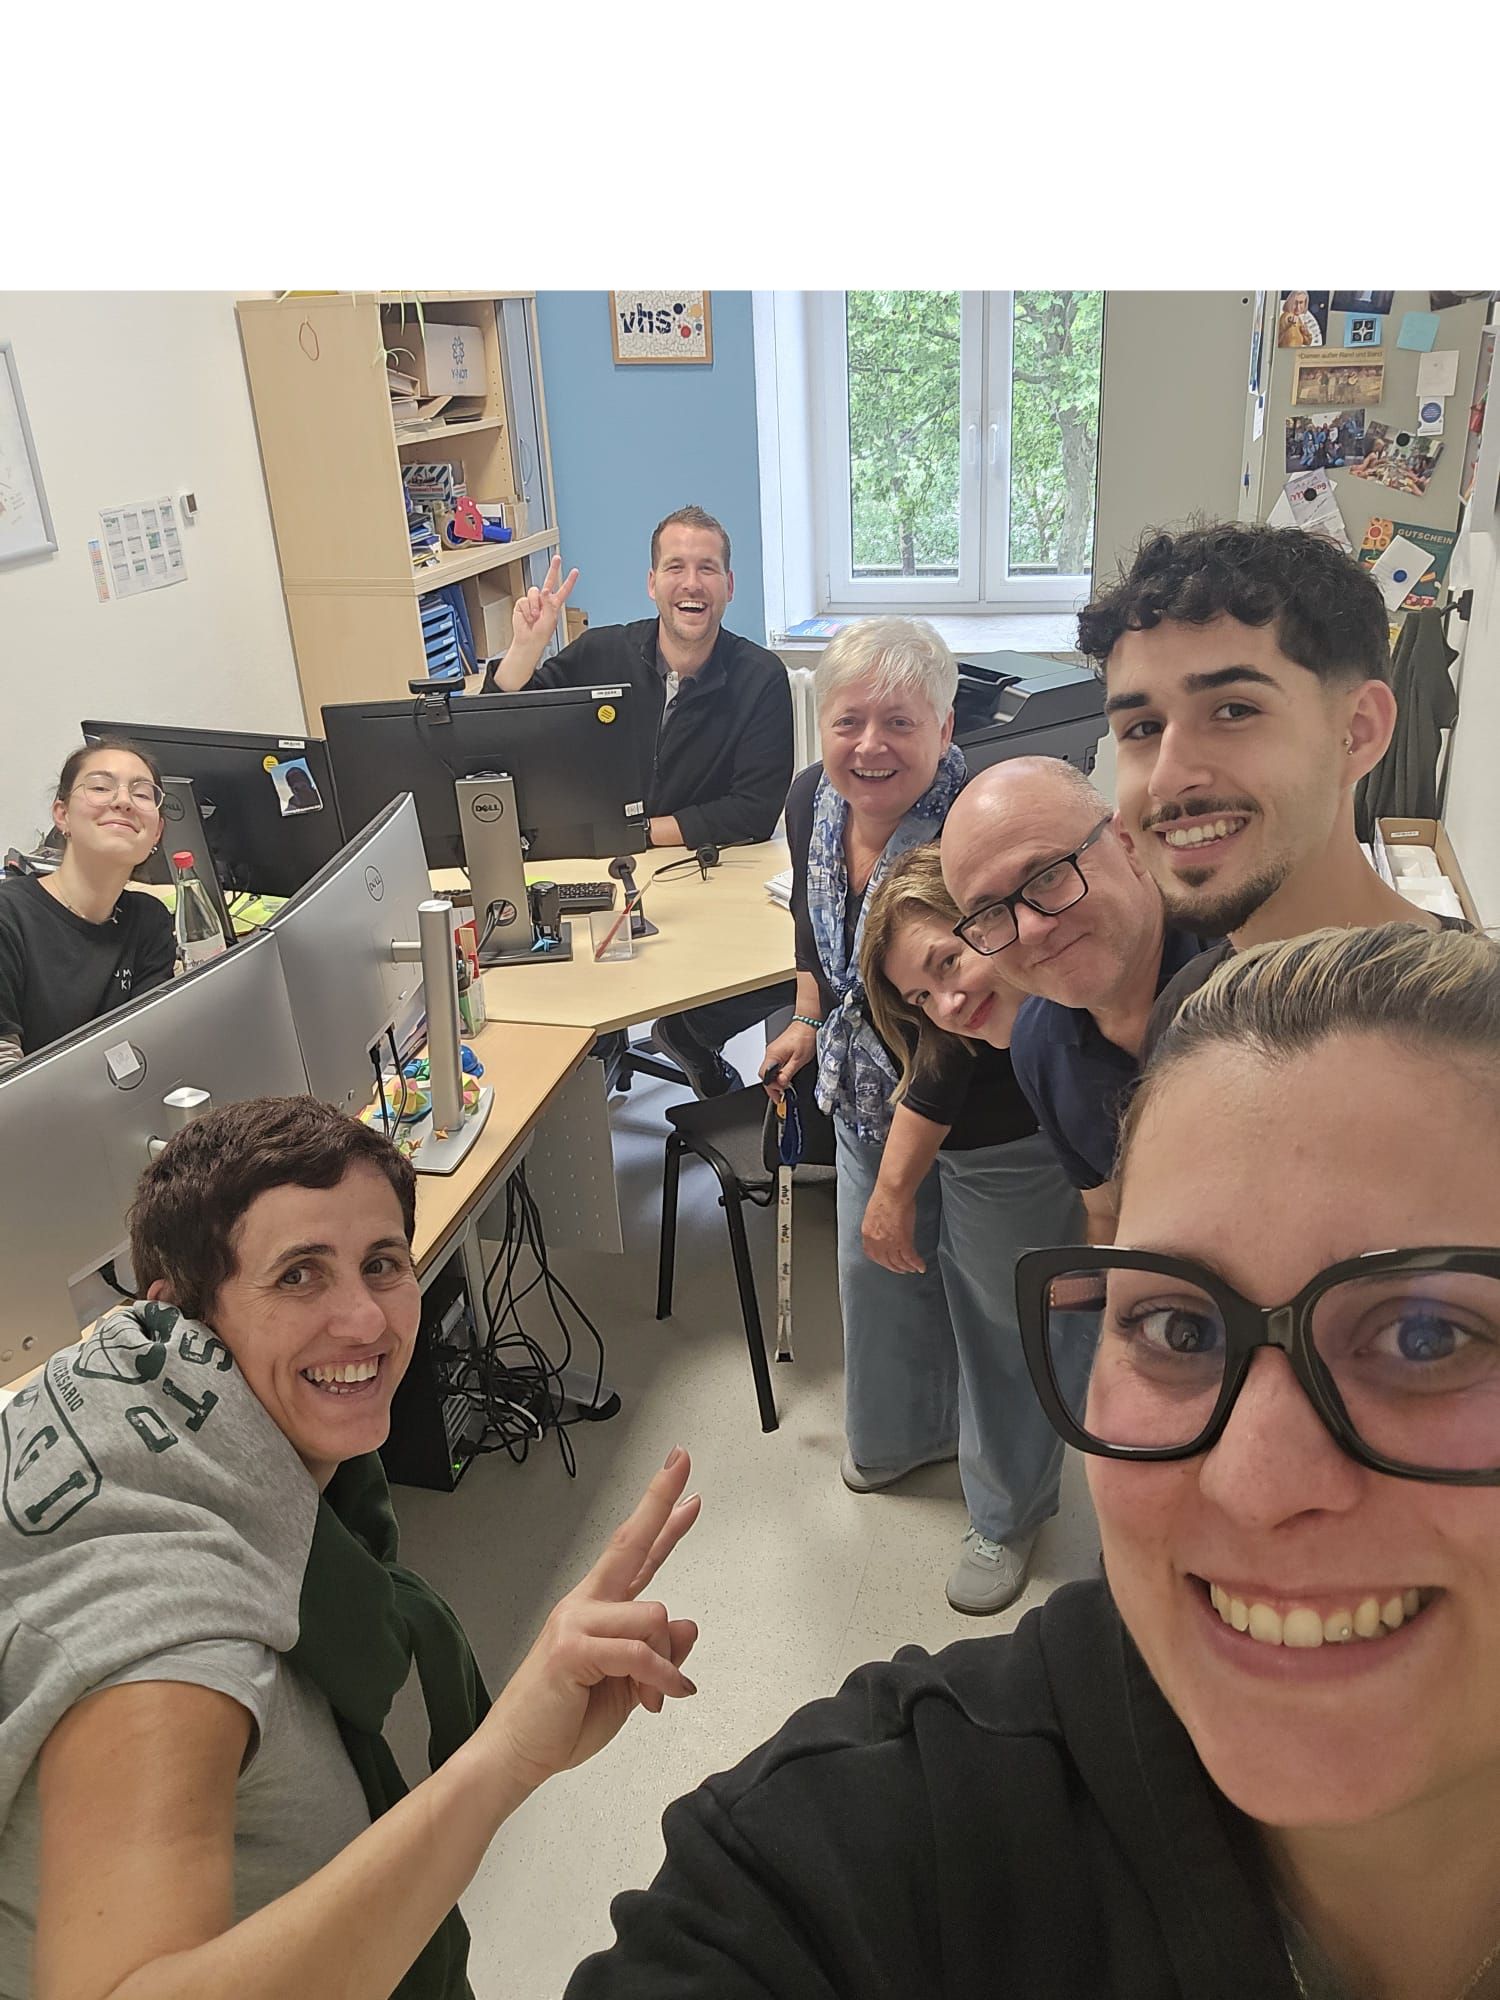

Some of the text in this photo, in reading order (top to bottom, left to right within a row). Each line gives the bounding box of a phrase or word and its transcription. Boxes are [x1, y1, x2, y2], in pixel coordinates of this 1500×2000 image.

[619, 302, 672, 334] vhs
[1397, 528, 1454, 545] GUTSCHEIN
[475, 804, 500, 813] DELL
